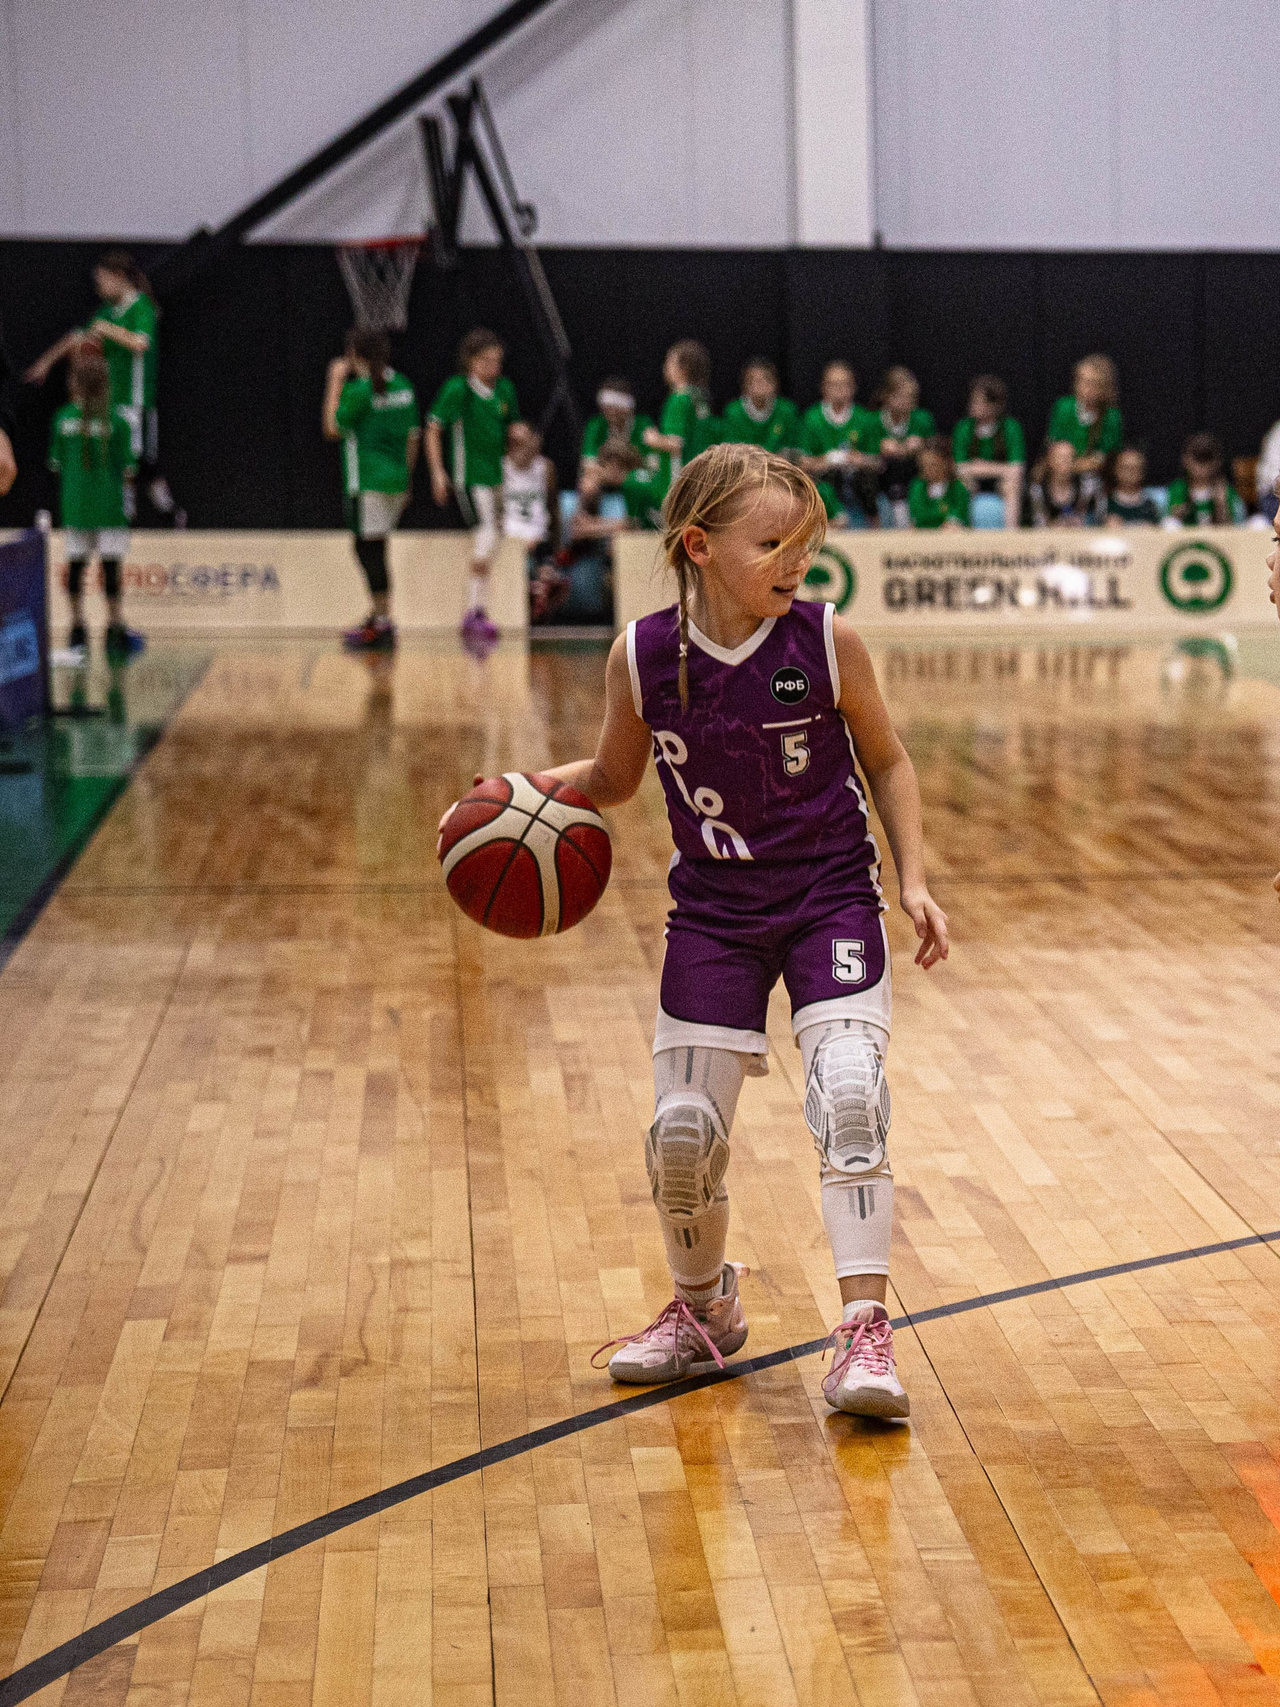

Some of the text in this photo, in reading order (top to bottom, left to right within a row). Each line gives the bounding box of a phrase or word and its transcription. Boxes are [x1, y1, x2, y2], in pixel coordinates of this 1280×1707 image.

[775, 680, 805, 692] РФБ
[781, 730, 811, 777] 5
[832, 938, 867, 985] 5
